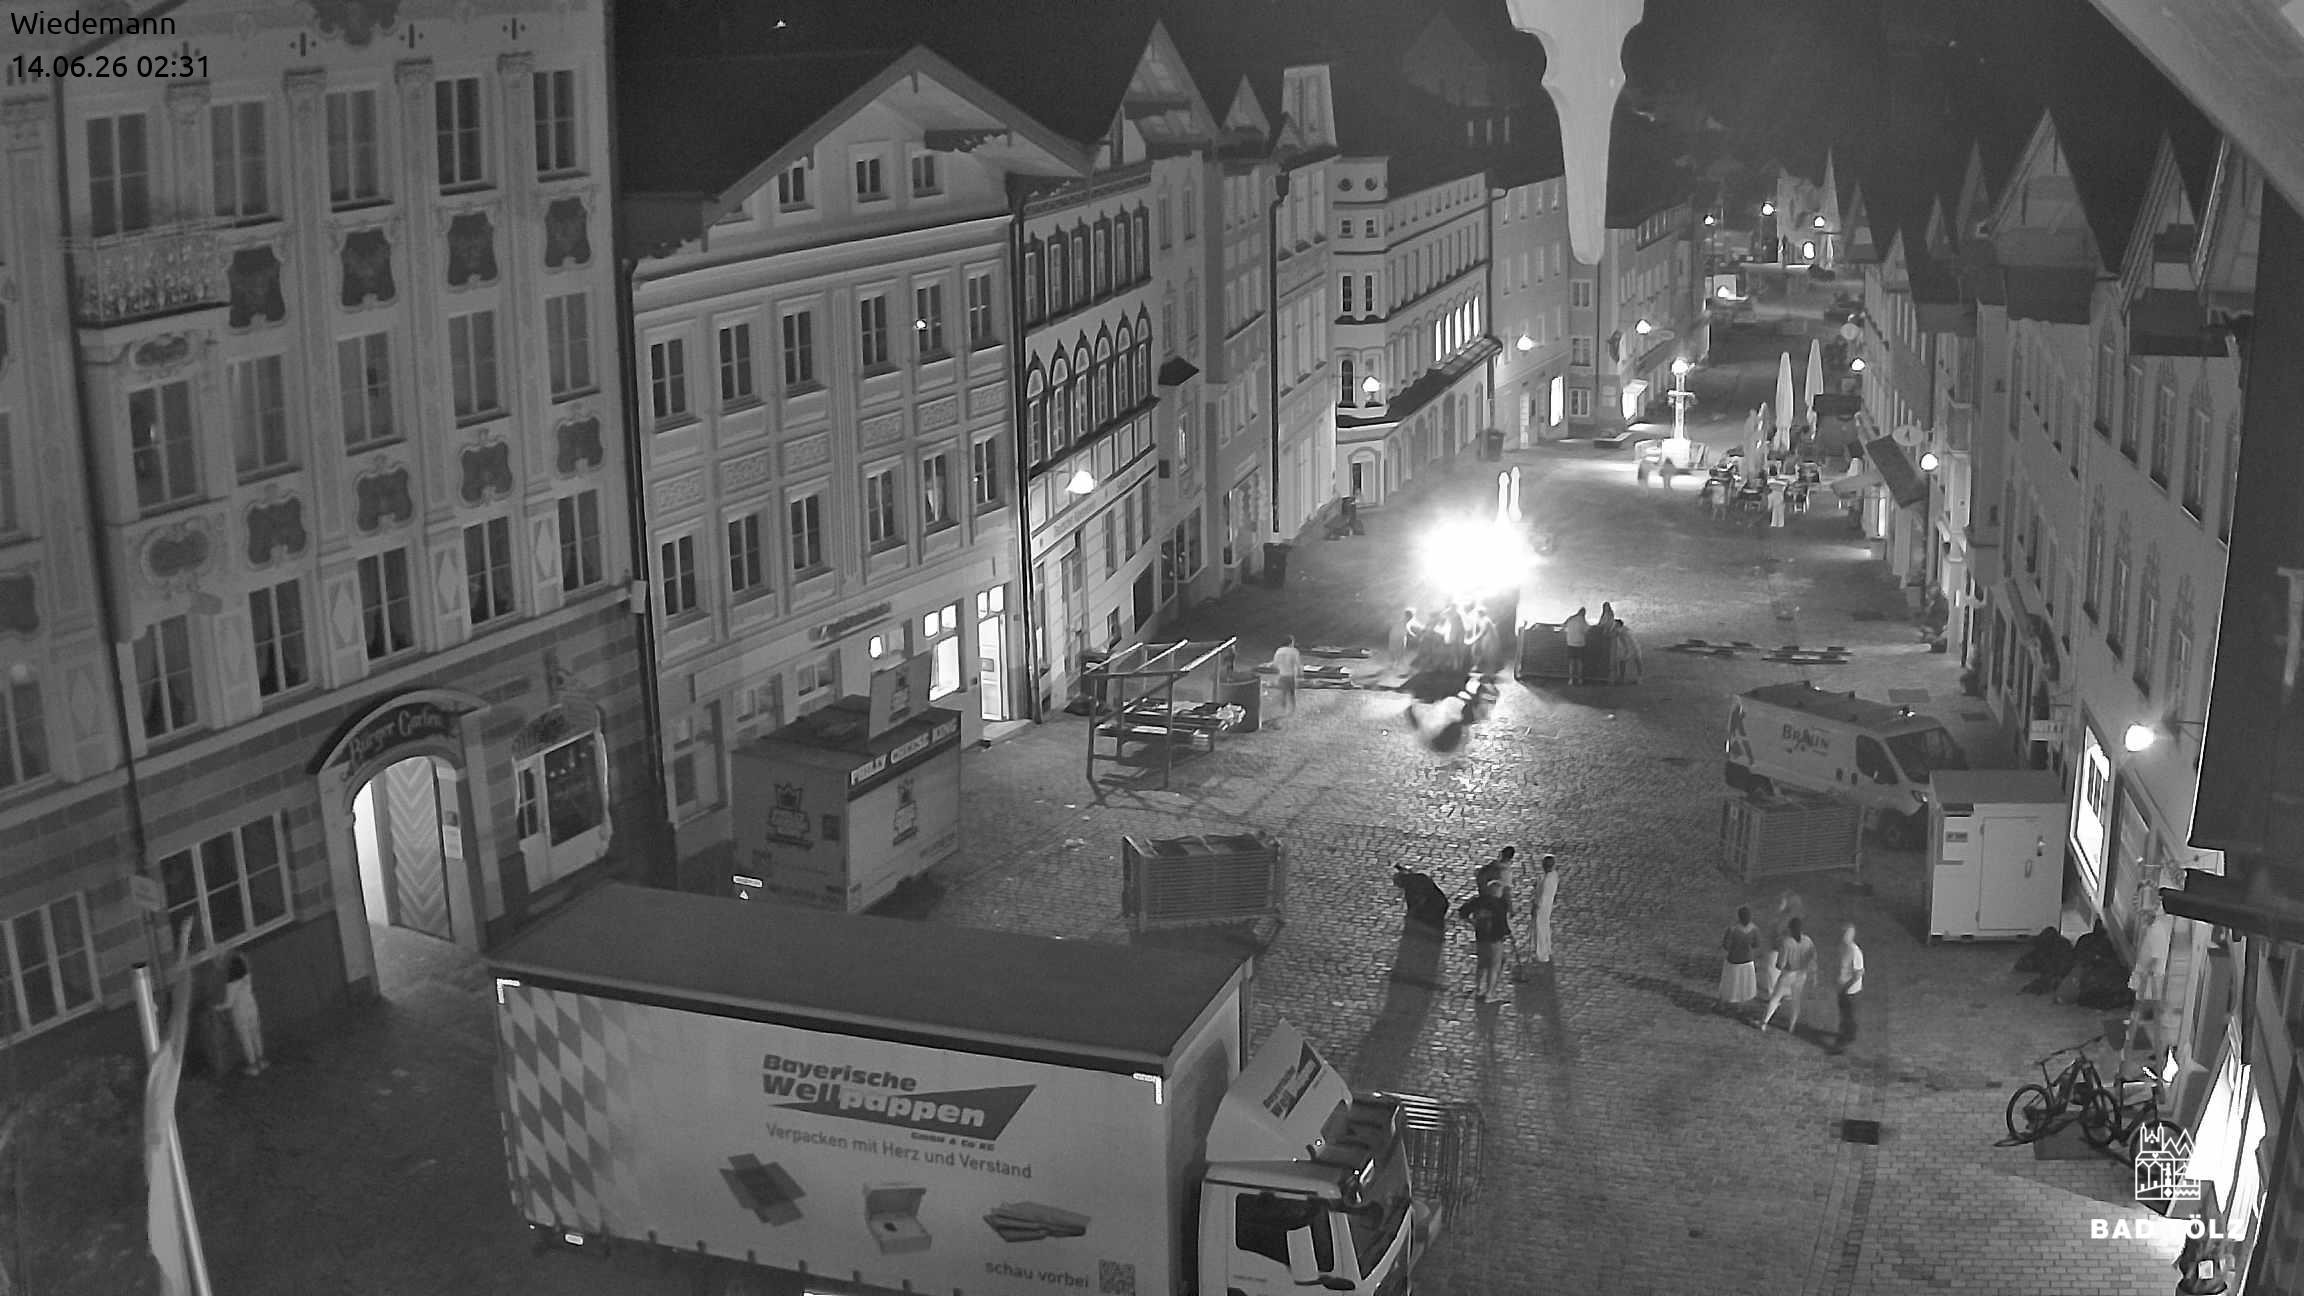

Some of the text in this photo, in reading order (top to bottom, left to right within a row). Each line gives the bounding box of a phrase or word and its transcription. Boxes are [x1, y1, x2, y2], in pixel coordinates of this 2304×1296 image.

[762, 1053, 917, 1092] Bayerische
[762, 1073, 985, 1128] Wellpappen
[765, 1121, 1033, 1179] Verpacken mit Herz und Verstand
[985, 1260, 1089, 1289] schau vorbei
